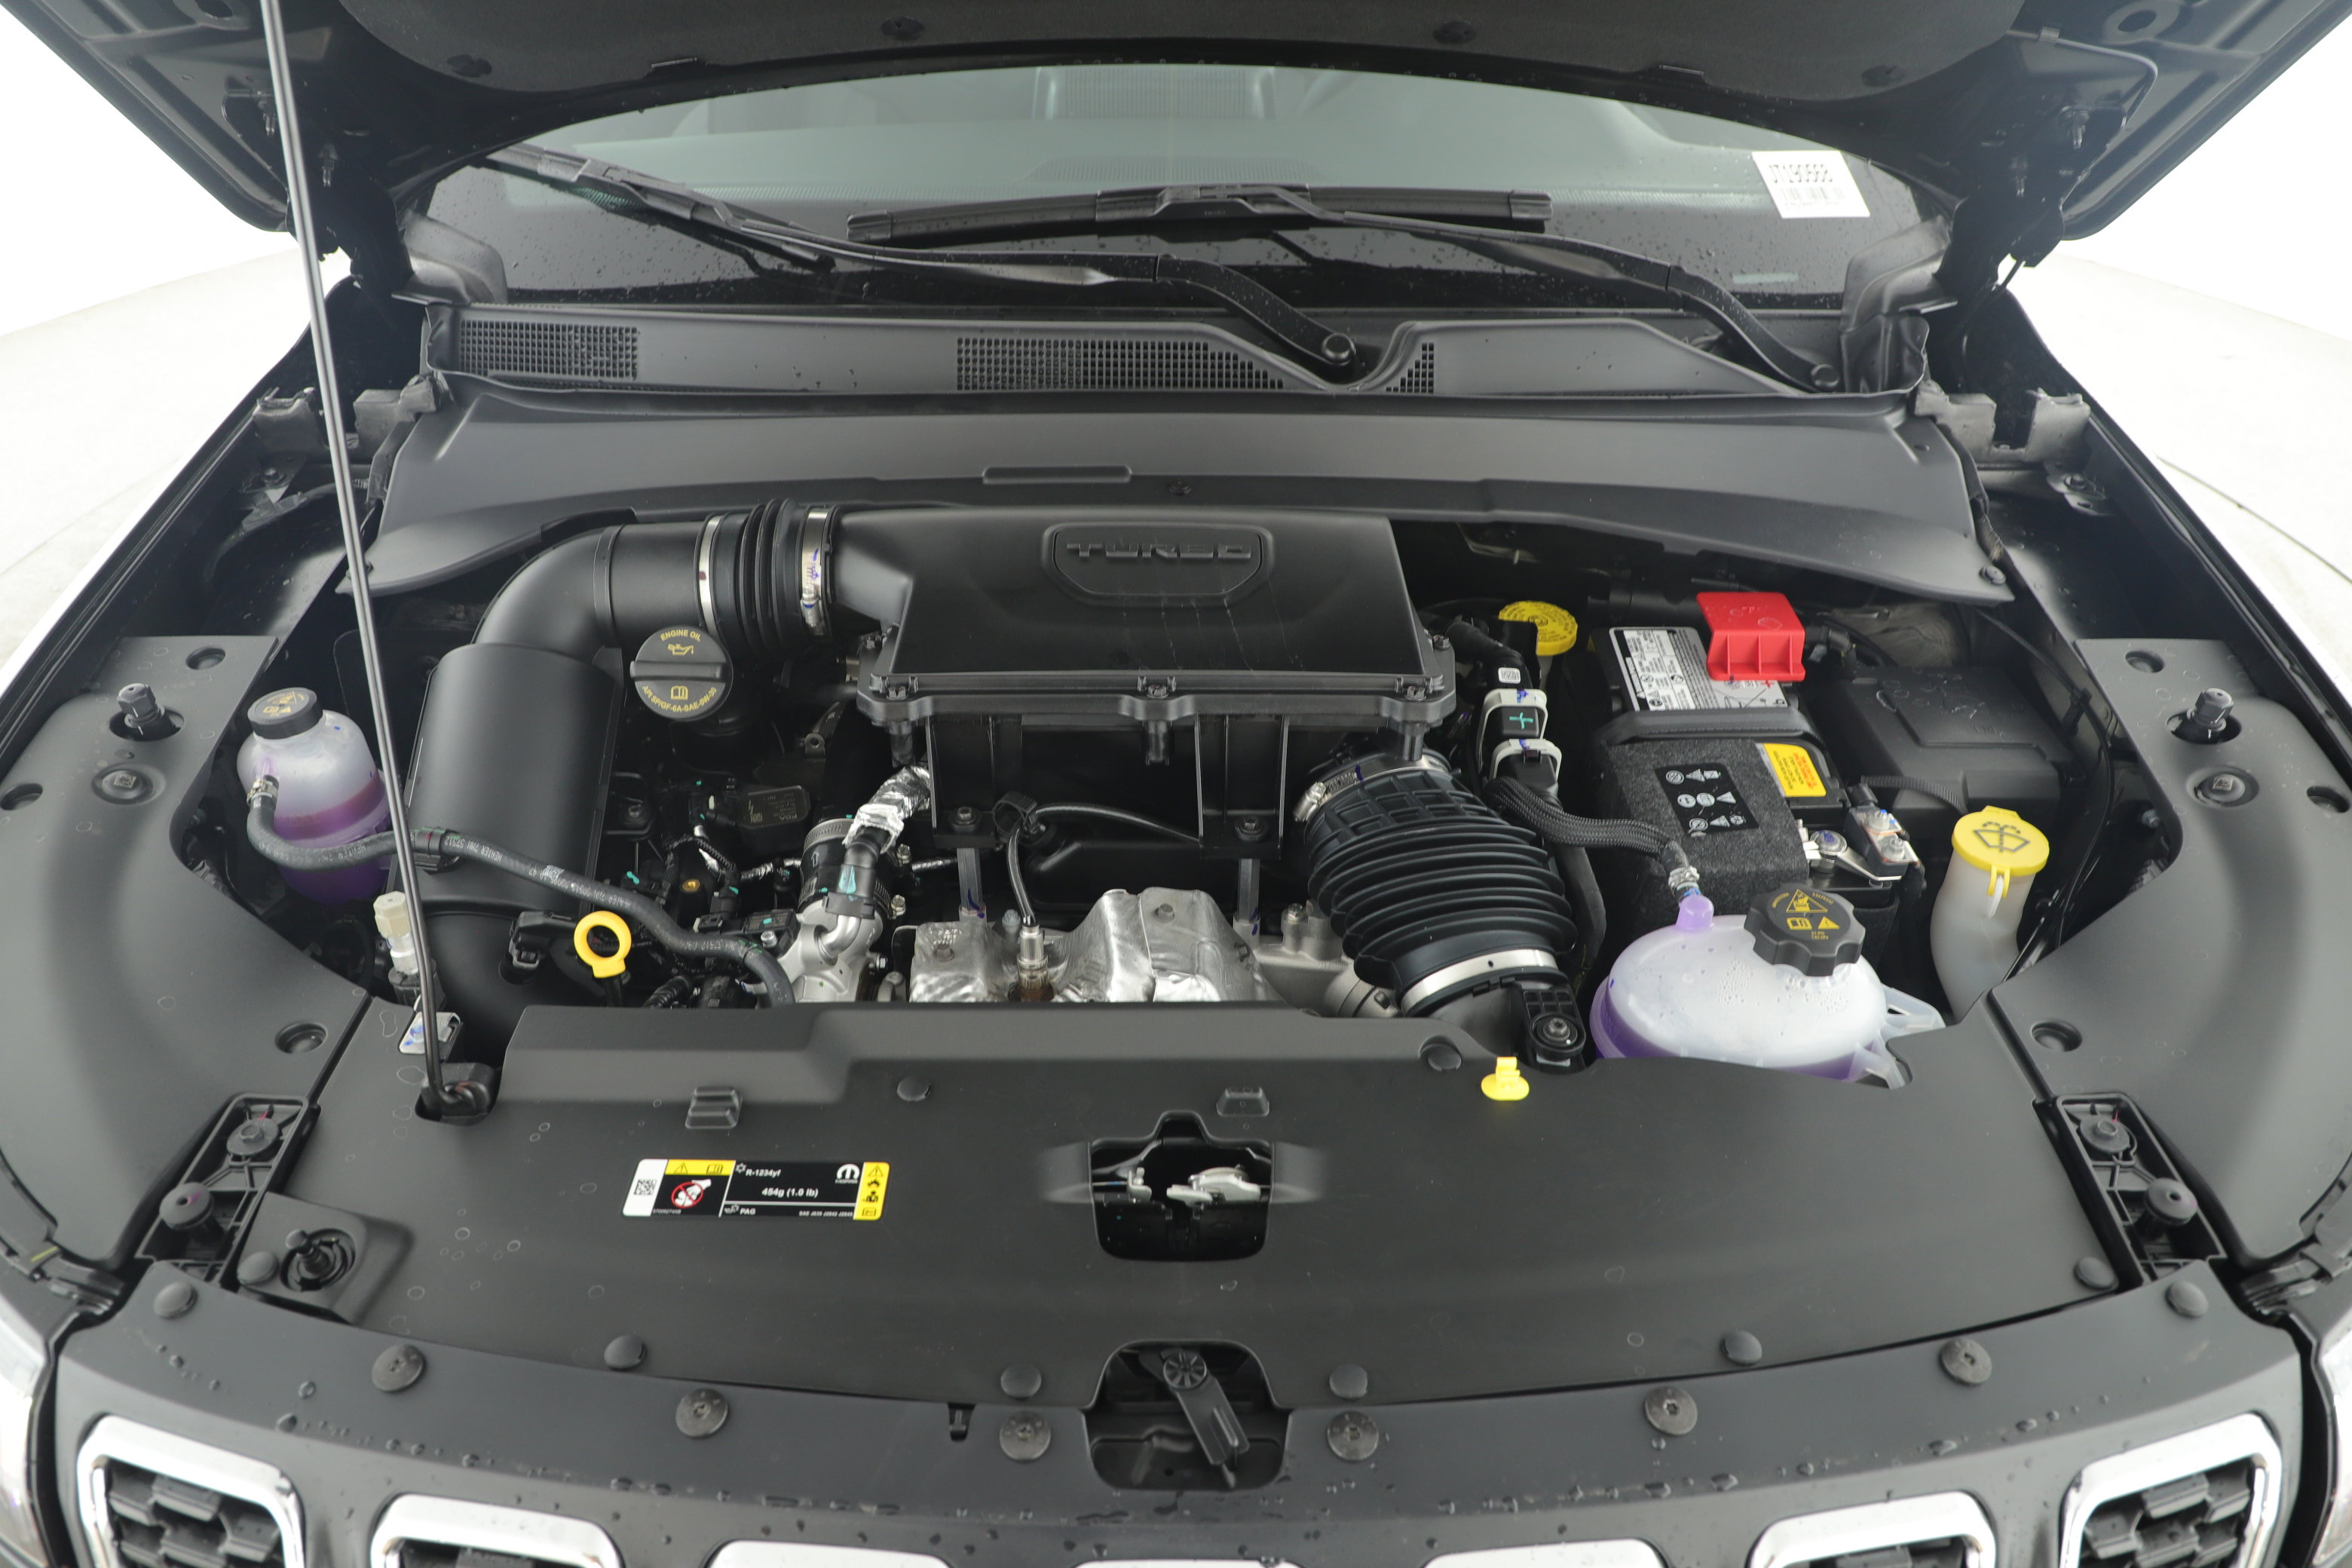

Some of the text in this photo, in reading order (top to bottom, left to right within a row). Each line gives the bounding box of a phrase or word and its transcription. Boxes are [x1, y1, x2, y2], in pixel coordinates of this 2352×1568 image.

[660, 629, 701, 642] ENGINE OIL
[642, 685, 652, 698] API
[481, 845, 503, 862] HEATER
[745, 1168, 782, 1178] R-1234yf
[761, 1187, 785, 1199] 454g
[786, 1187, 804, 1199] (1.0
[740, 1208, 756, 1216] PAG
